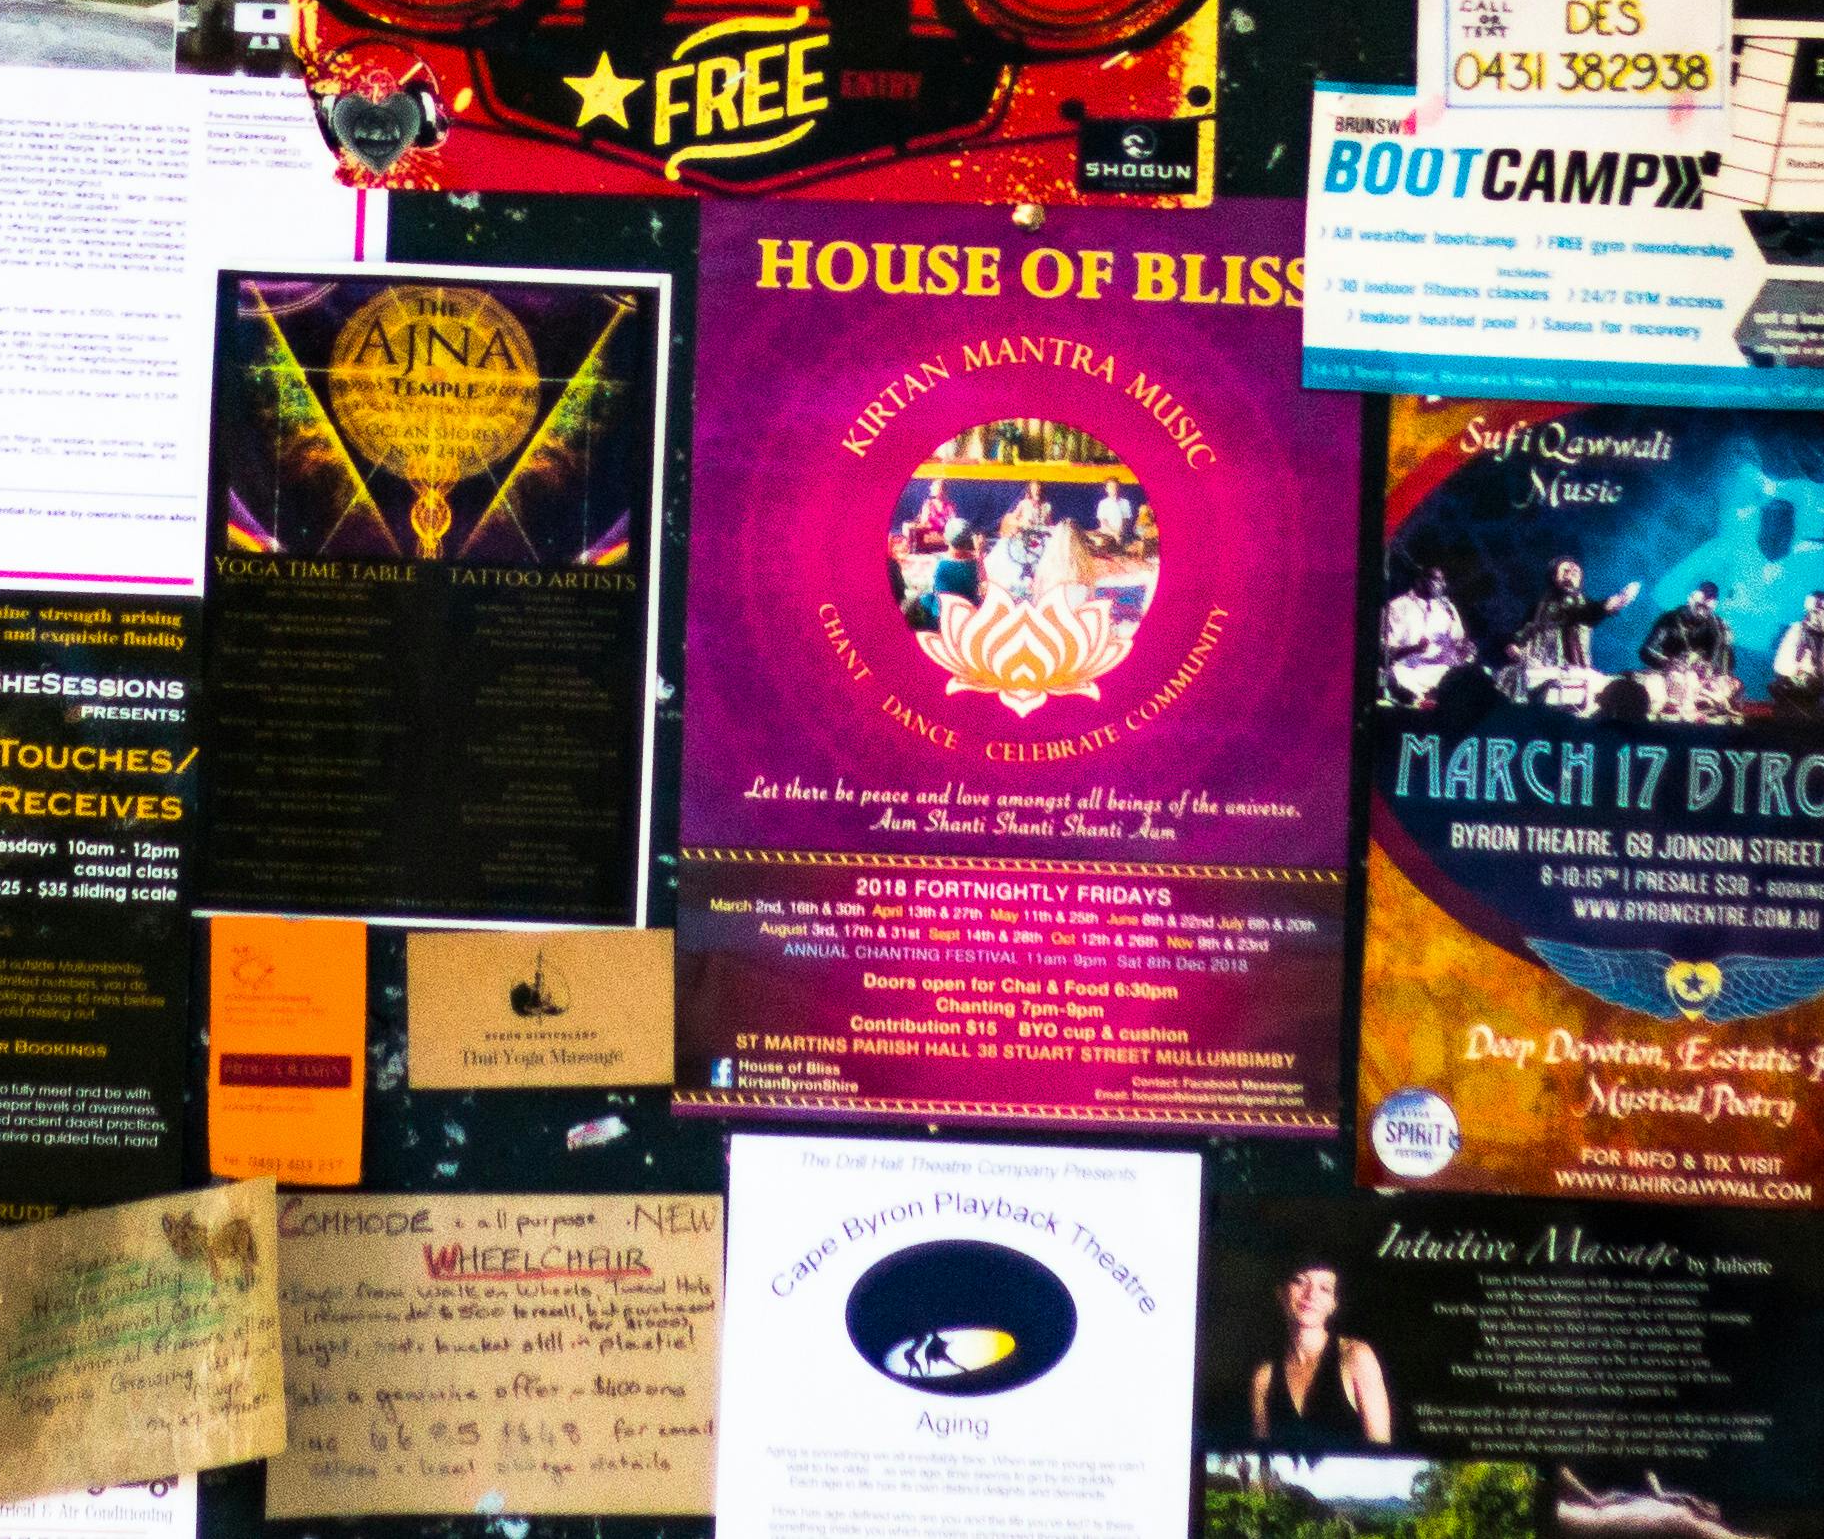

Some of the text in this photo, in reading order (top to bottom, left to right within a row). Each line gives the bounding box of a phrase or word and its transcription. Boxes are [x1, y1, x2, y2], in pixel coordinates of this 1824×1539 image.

[653, 32, 829, 146] FREE
[1453, 51, 1712, 94] 0431 382938
[1084, 160, 1192, 180] SHOGUN
[1323, 139, 1661, 208] BOOTCAMP
[756, 237, 1306, 307] HOUSE OF BLISS
[355, 320, 519, 376] AJNA
[391, 378, 478, 398] TEMPLE
[840, 335, 1217, 471] KIRTAN MANTRA MUSIC
[1459, 417, 1671, 463] Sufi Qawwali
[1513, 471, 1623, 510] Music
[215, 556, 416, 583] YOGA TIME TABLE
[448, 567, 636, 591] TATTOO ARTISTS
[818, 603, 1230, 763] CHANT DANCE CELEBRATE COMMUNITY
[81, 705, 186, 722] PRESENTS:
[1396, 732, 1596, 807] MARCH
[1616, 746, 1667, 809] 17
[68, 840, 114, 857] 10am
[134, 842, 179, 861] 12pm
[75, 863, 178, 880] casual class
[856, 879, 1172, 906] 2018 FORTNIGHTLY FRIDAYS
[1556, 1170, 1811, 1204] WWW.TAHIRQAWWAL.COM
[424, 1242, 650, 1280] WHEELCHAIR
[771, 1191, 1156, 1317] Cape Byron Playback Theatre
[1377, 1220, 1773, 1276] Intuitive Massage by Juliette
[916, 1411, 990, 1440] Aging
